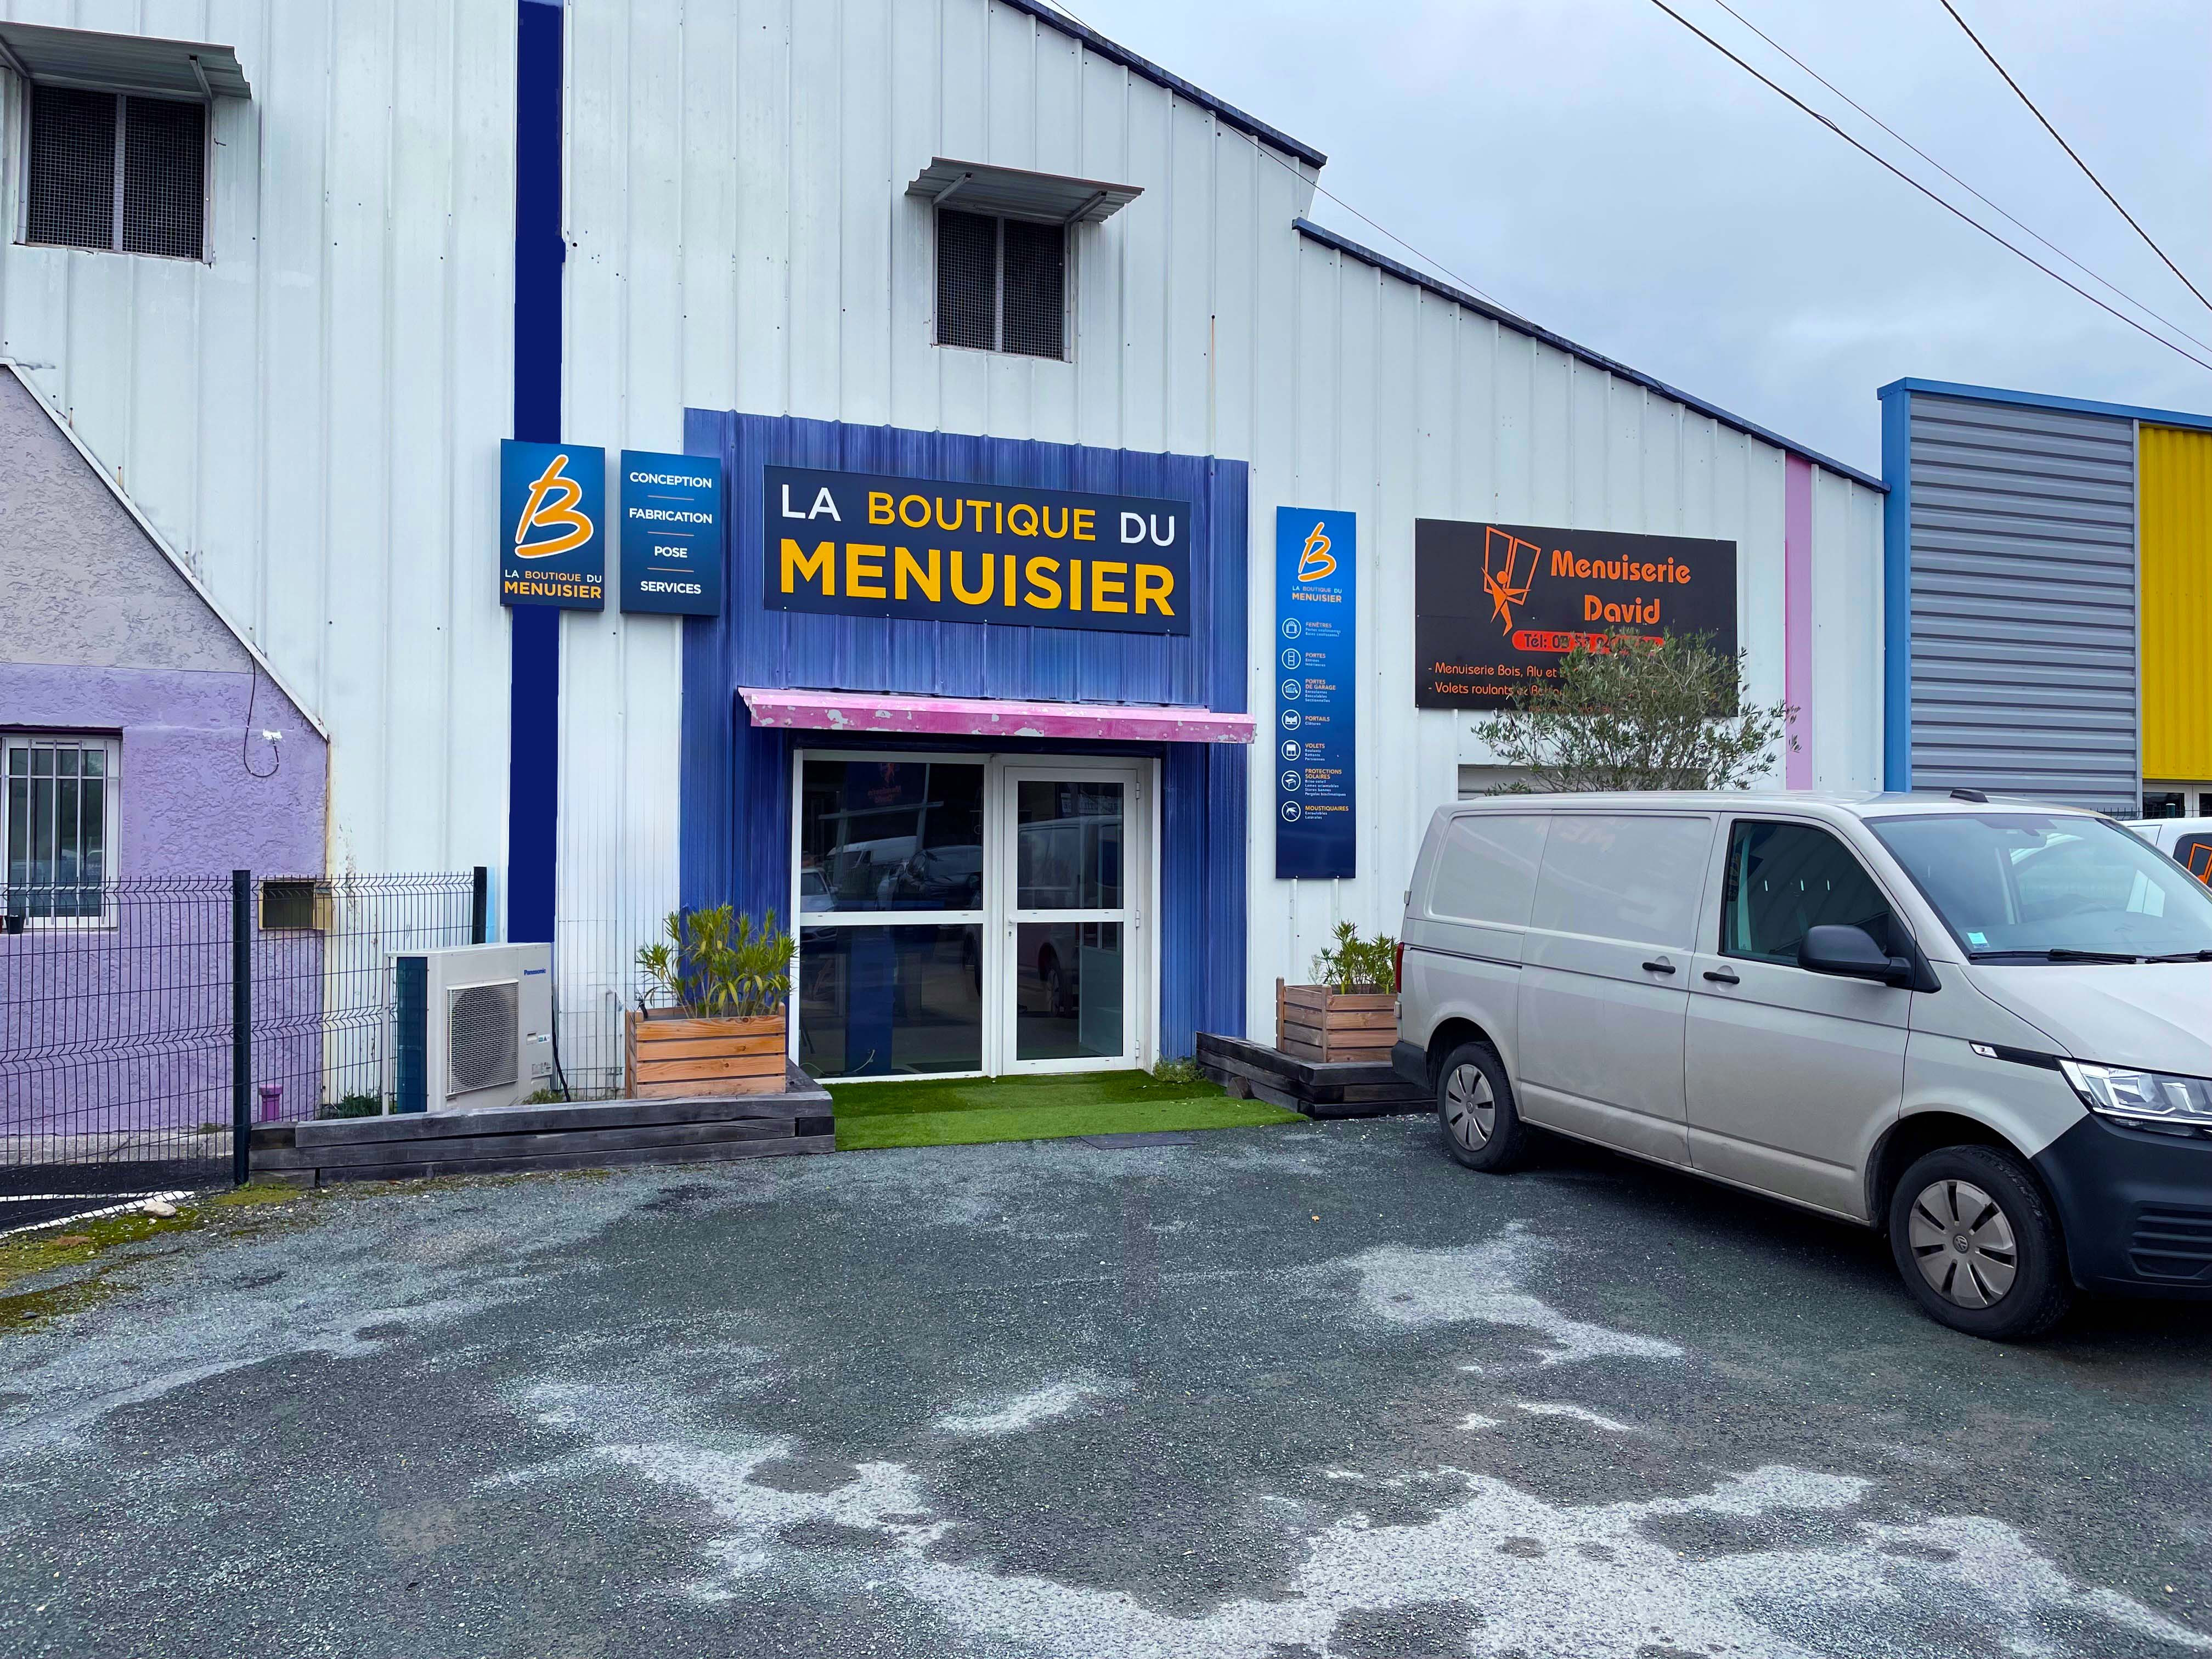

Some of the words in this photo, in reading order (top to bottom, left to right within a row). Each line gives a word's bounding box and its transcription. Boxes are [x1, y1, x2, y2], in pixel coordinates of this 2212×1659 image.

[629, 472, 712, 488] CONCEPTION
[629, 507, 712, 524] FABRICATION
[781, 484, 841, 522] LA
[868, 491, 1096, 541] BOUTIQUE
[1120, 512, 1175, 546] DU
[654, 546, 687, 558] POSE
[1550, 550, 1691, 584] Menuiserie
[505, 569, 519, 578] LA
[525, 571, 581, 582] BOUTIQUE
[587, 574, 602, 583] DU
[780, 539, 1175, 616] MENUISIER
[504, 582, 601, 599] MENUISIER
[640, 580, 701, 595] SERVICES
[1292, 592, 1342, 603] MENUISIER
[1584, 594, 1660, 624] David
[1524, 633, 1547, 648] Tél:
[1435, 662, 1494, 675] Menuiserie
[1498, 664, 1523, 678] Bois,
[1527, 665, 1542, 677] Alu
[1545, 668, 1557, 678] et
[1435, 681, 1469, 694] Volets
[1471, 684, 1513, 695] roulants
